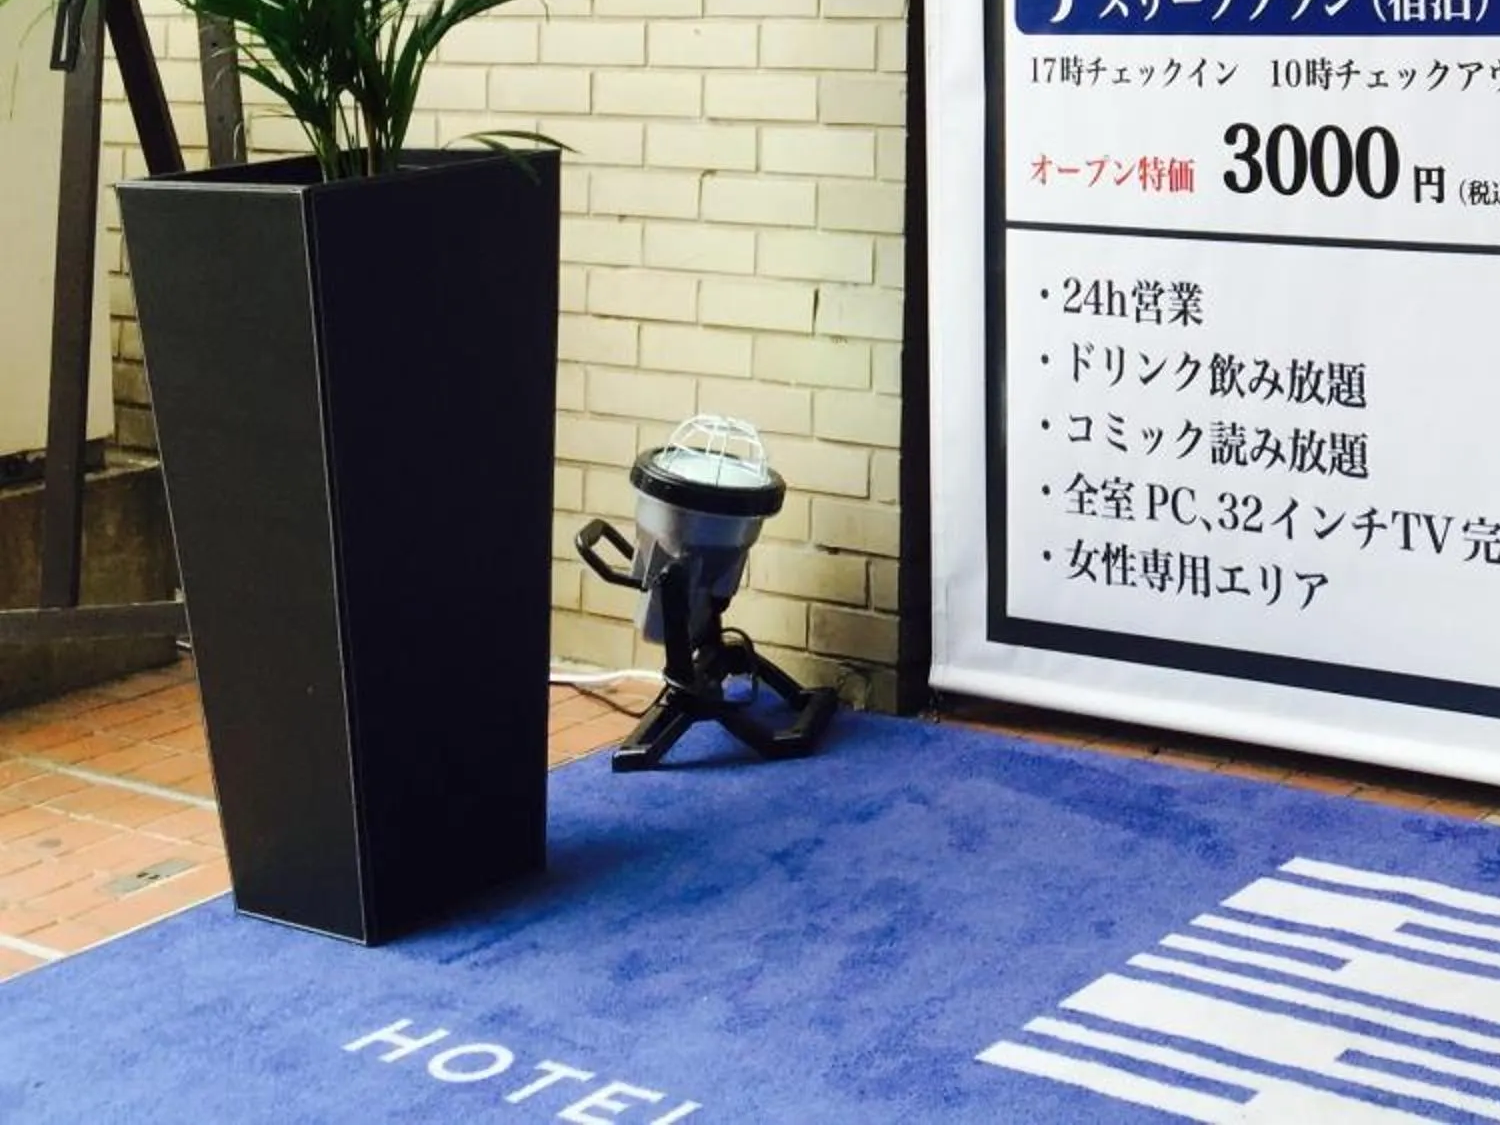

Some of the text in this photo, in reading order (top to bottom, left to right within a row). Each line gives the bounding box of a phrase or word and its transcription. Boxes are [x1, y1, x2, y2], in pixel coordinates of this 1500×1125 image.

[1031, 54, 1239, 91] 17時チェックイン
[1031, 155, 1195, 194] オープン特価
[1222, 121, 1401, 201] 3000
[1413, 164, 1447, 205] 円
